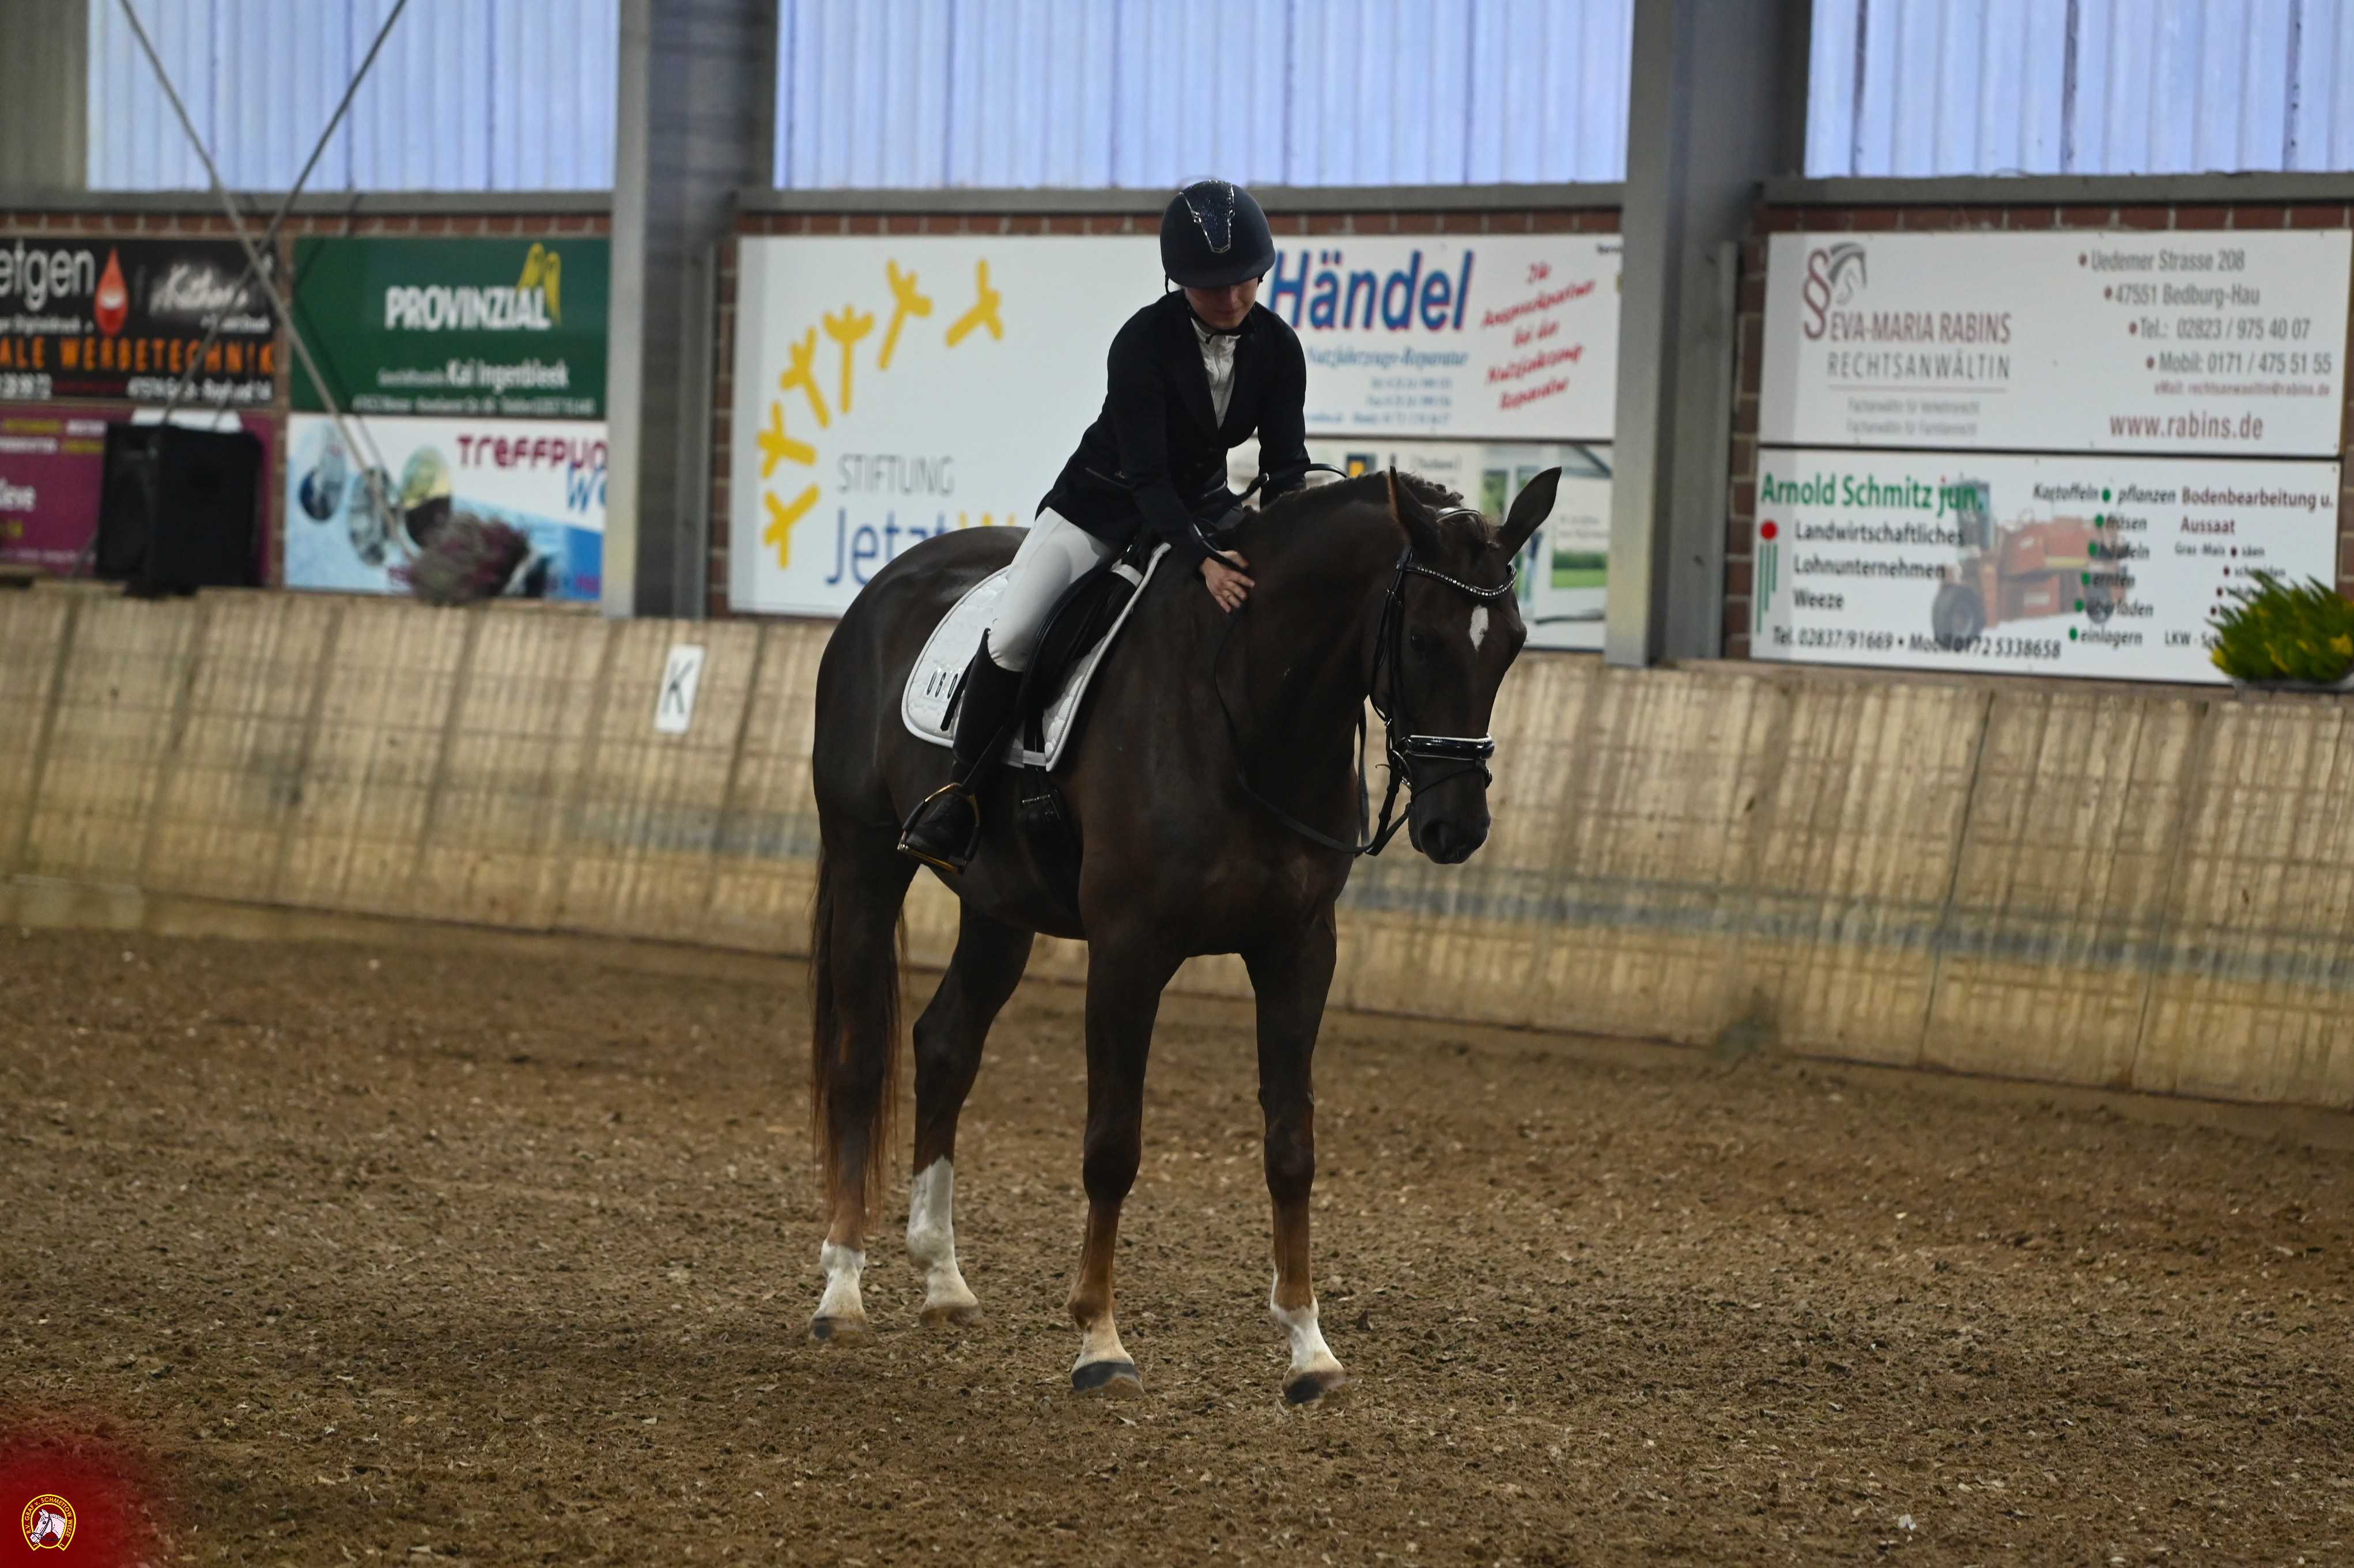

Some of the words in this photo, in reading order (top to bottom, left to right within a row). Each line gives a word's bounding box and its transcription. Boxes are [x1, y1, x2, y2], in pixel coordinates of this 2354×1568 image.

[2091, 250, 2154, 271] Uedemer
[2158, 250, 2214, 271] Strasse
[2217, 249, 2245, 271] 208
[1268, 250, 1474, 332] Händel
[2115, 283, 2157, 305] 47551
[2162, 284, 2260, 309] Bedburg-Hau
[384, 285, 552, 331] PROVINZIAL
[1830, 311, 1934, 342] EVA-MARIA
[1939, 312, 2012, 345] RABINS
[2176, 318, 2222, 339] 02823
[2236, 318, 2264, 339] 975
[2269, 318, 2288, 339] 40
[2292, 318, 2311, 339] 07
[1827, 349, 2011, 380] RECHTSANWÄLTIN
[2208, 352, 2242, 374] 0171
[2258, 352, 2285, 375] 475
[2289, 352, 2307, 375] 51
[2313, 352, 2332, 375] 55
[2109, 410, 2264, 440] www.rabins.de
[837, 453, 957, 497] STIFTUNG
[1760, 472, 1835, 506] Arnold
[1842, 474, 1932, 509] Schmitz
[2032, 482, 2099, 502] Kartoffeln
[2117, 483, 2177, 507] pflanzen
[2181, 486, 2317, 513] Bodenbearbeitung
[1795, 520, 1964, 545] Landwirtschaftliches
[2179, 515, 2236, 535] Aussaat
[824, 506, 950, 587] Jet
[1793, 553, 1947, 579] Lohnunternehmen
[1793, 587, 1844, 609] Weeze
[1994, 637, 2062, 660] 5338658
[2080, 629, 2144, 650] einlagern
[2164, 630, 2191, 646] LKW
[663, 659, 695, 715] K
